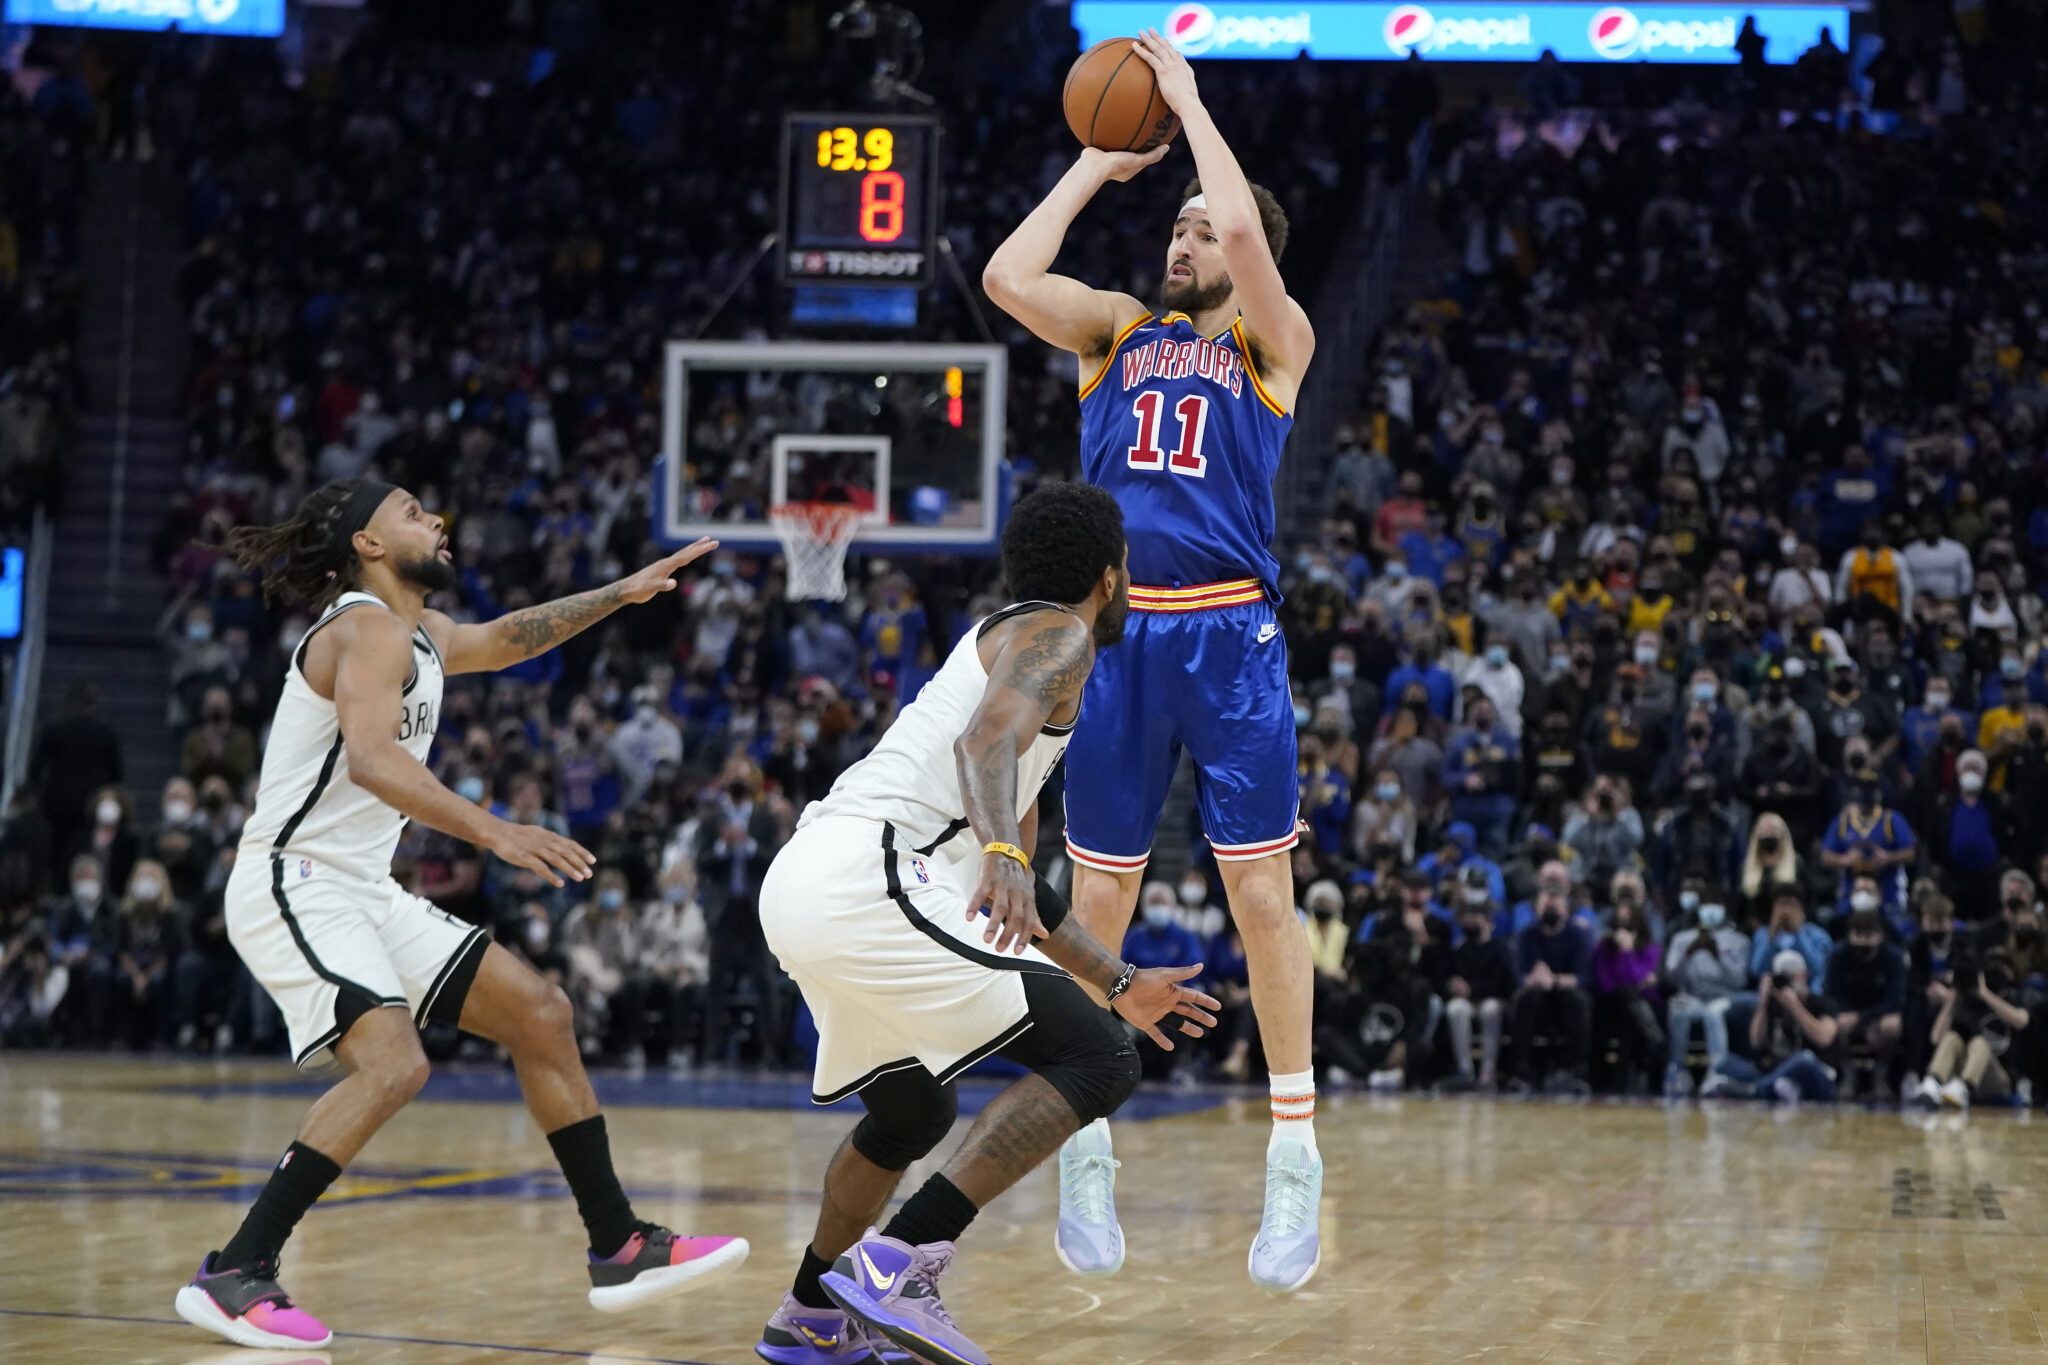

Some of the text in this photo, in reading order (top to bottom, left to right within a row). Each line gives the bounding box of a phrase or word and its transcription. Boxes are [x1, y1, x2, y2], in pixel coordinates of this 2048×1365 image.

[1216, 12, 1310, 49] pepsi
[1434, 14, 1530, 50] pepsi
[1641, 16, 1735, 53] pepsi
[818, 127, 893, 171] 13.9
[860, 171, 905, 242] 8
[827, 252, 924, 275] TISSOT
[1123, 337, 1245, 399] WARRIORS
[1127, 390, 1209, 478] 11
